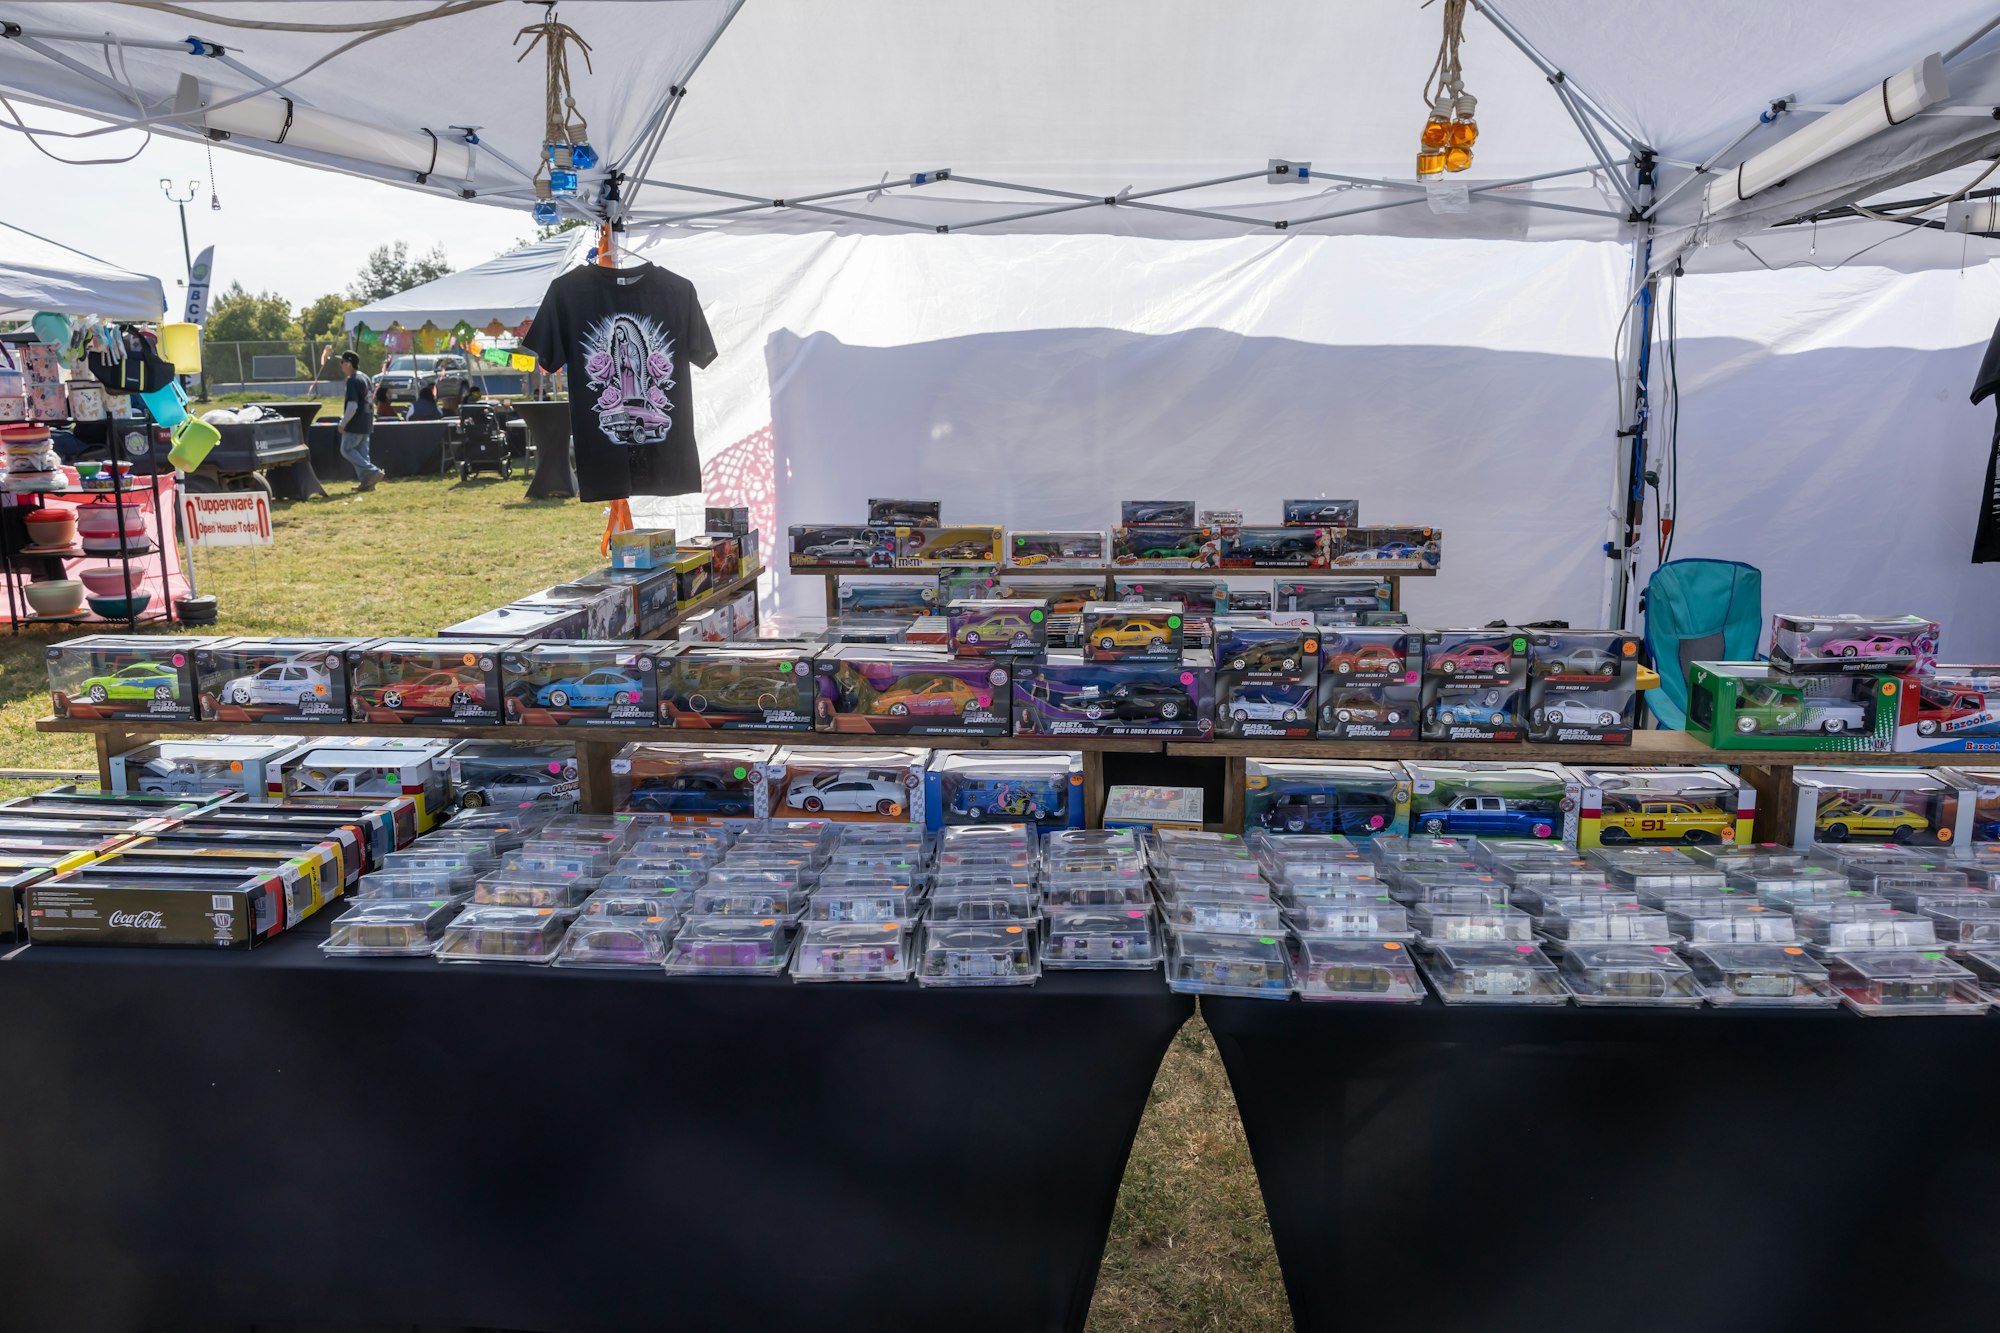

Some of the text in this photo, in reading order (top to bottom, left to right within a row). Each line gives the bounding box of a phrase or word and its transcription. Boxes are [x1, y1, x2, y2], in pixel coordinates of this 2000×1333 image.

[194, 496, 254, 514] Tupperware
[199, 521, 259, 536] Open House Today
[150, 705, 191, 713] FURIOUS
[302, 707, 344, 715] FURIOUS
[454, 710, 497, 718] FURIOUS
[611, 711, 655, 719] FURIOUS
[1776, 711, 1798, 726] Sprite
[766, 715, 811, 724] FURIOUS
[964, 717, 1008, 725] FURIOUS
[1945, 713, 1993, 731] Bazooka
[1053, 726, 1099, 734] FURIOUS
[1452, 732, 1494, 740] FURIOUS
[557, 782, 580, 792] LOVE
[1641, 819, 1667, 831] 91
[108, 909, 163, 929] Coca-Cola
